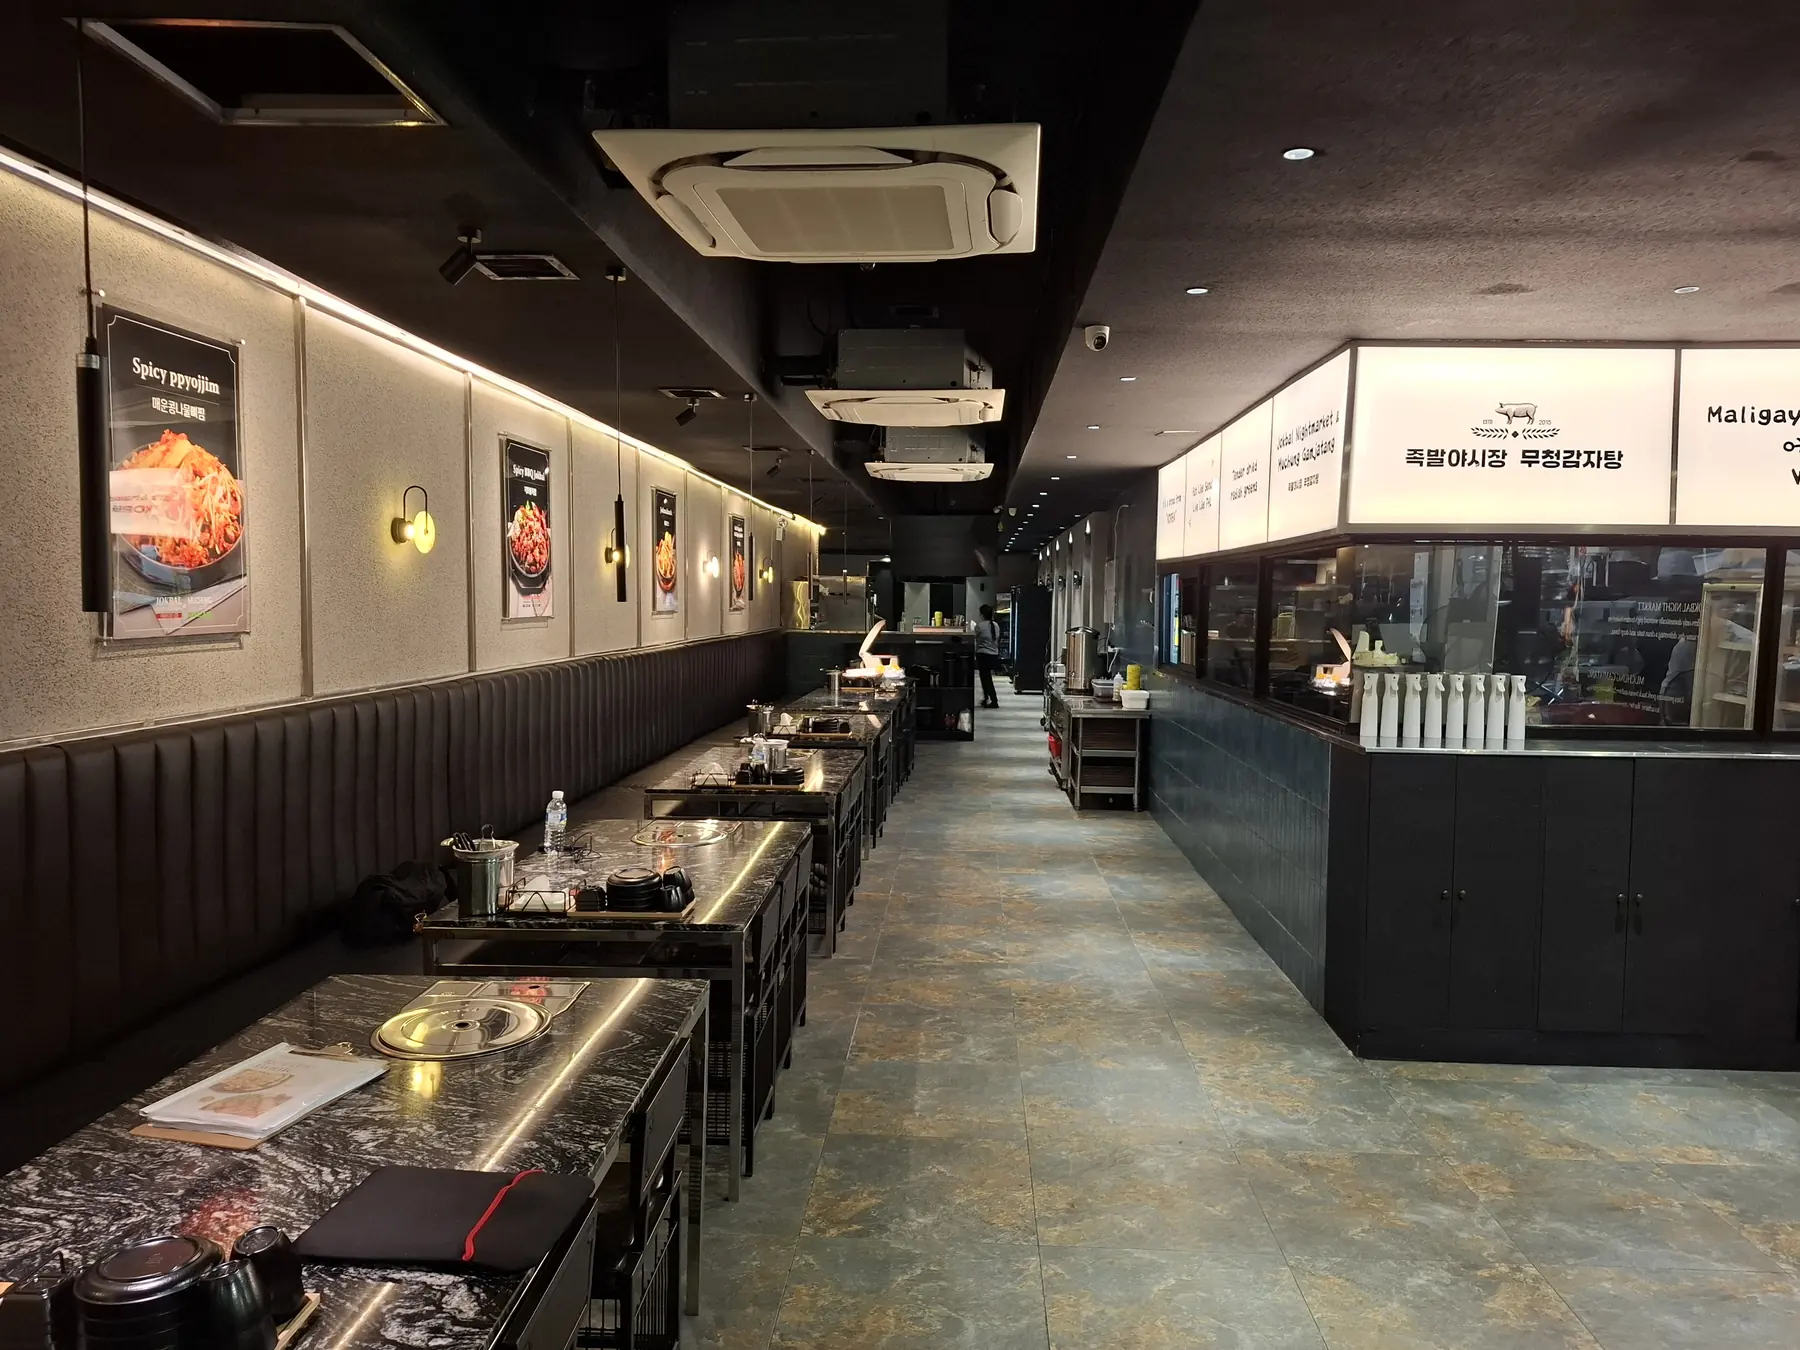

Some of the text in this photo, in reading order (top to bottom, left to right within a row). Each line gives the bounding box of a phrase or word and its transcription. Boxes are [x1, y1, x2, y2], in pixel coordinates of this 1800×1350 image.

[132, 356, 220, 395] Spicy ppyojjim
[1296, 409, 1334, 442] Nightmarket
[1405, 448, 1624, 470] 족발야시장 무청감자탕
